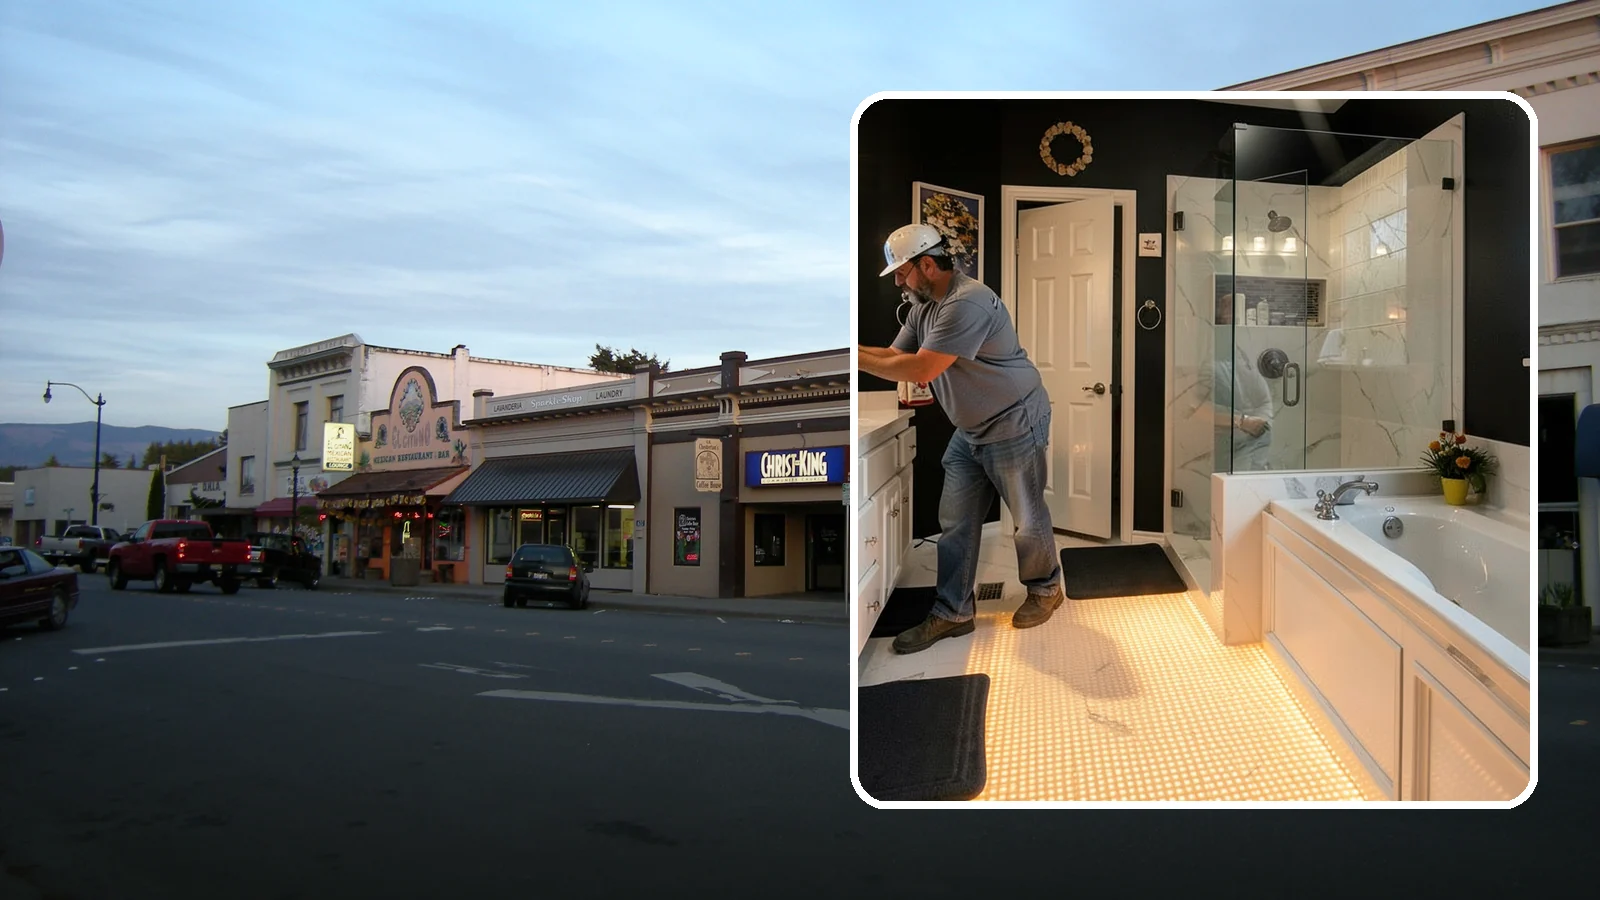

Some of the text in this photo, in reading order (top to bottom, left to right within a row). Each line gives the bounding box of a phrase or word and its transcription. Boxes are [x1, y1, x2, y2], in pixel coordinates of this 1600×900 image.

[494, 388, 623, 412] LAVANDERIA Sparkle Shop LAUNDRY
[374, 454, 396, 464] MEXICAN
[397, 452, 433, 462] RESTAURANT
[438, 450, 450, 459] BAR
[760, 450, 828, 478] CHRIST KING
[696, 480, 709, 488] Coffee
